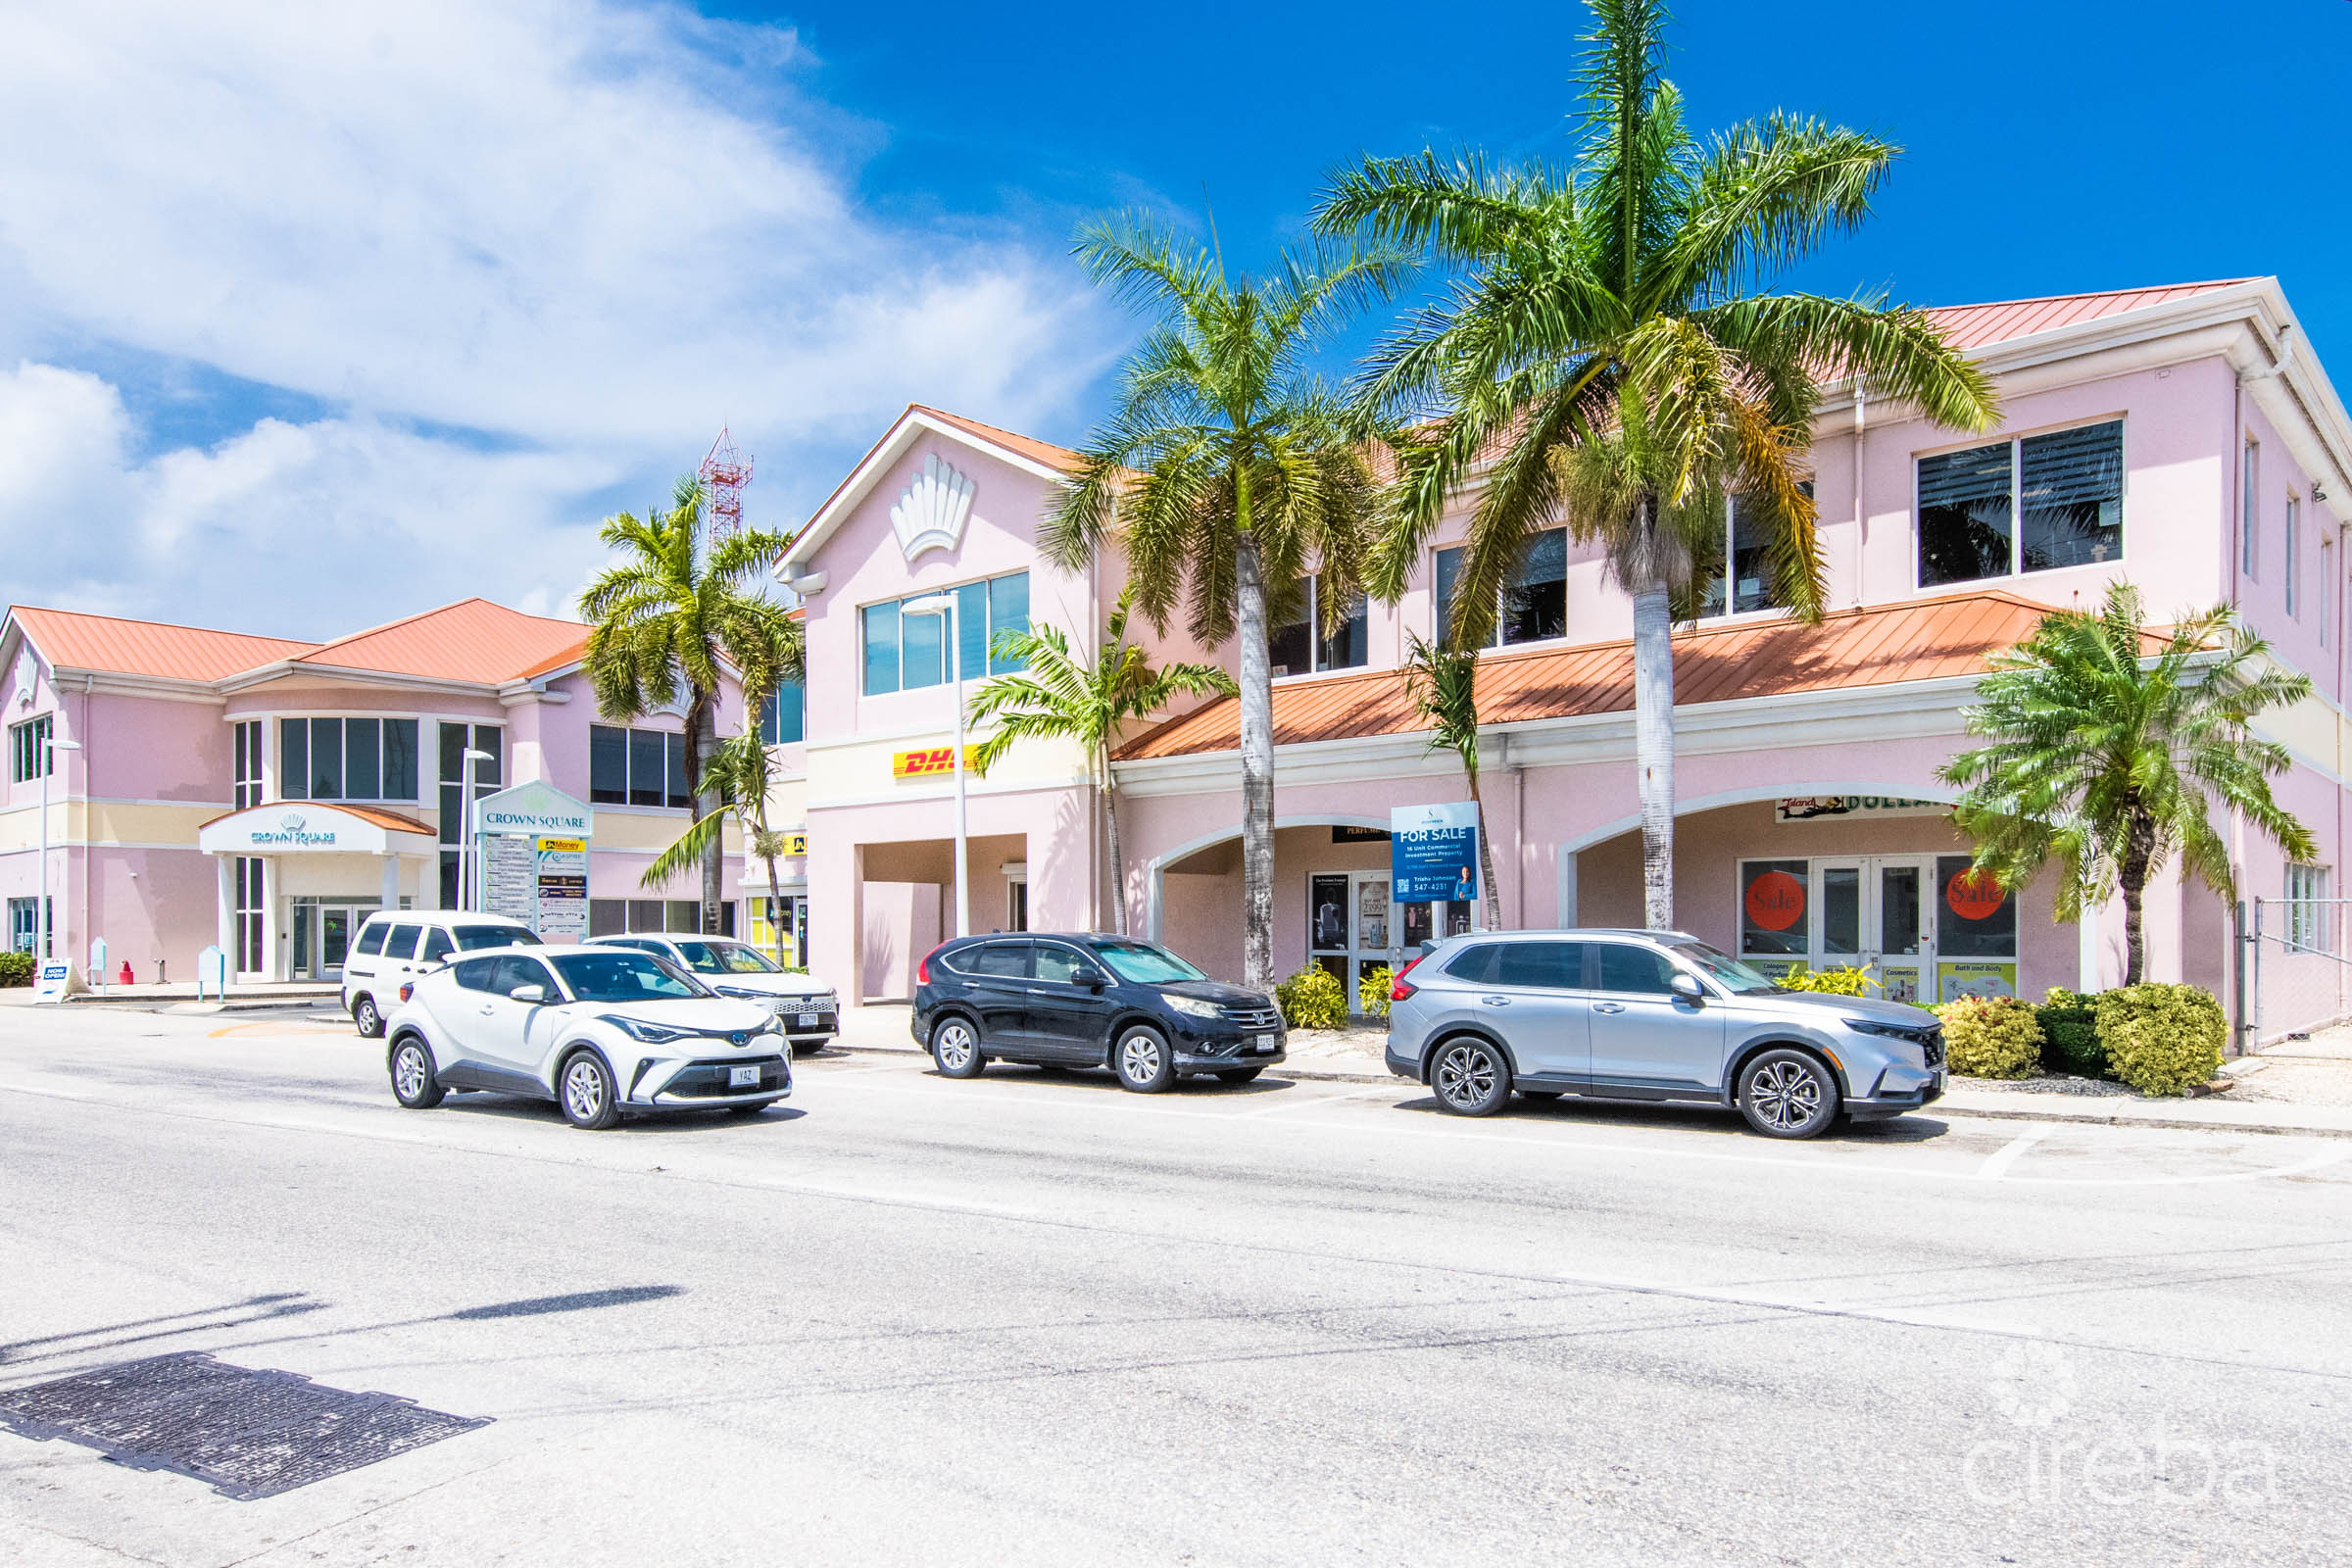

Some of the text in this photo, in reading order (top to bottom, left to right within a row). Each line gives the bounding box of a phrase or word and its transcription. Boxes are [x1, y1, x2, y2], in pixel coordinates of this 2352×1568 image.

[1782, 797, 1813, 808] Island
[1846, 796, 1949, 810] DOLLA
[486, 812, 585, 828] CROWN SQUARE
[251, 832, 335, 845] CROWN SQUARE
[1400, 826, 1467, 843] FOR SALE
[556, 841, 579, 850] Money
[1951, 880, 2000, 903] Sale
[1755, 889, 1796, 910] Sale
[1763, 962, 1788, 971] Colognes
